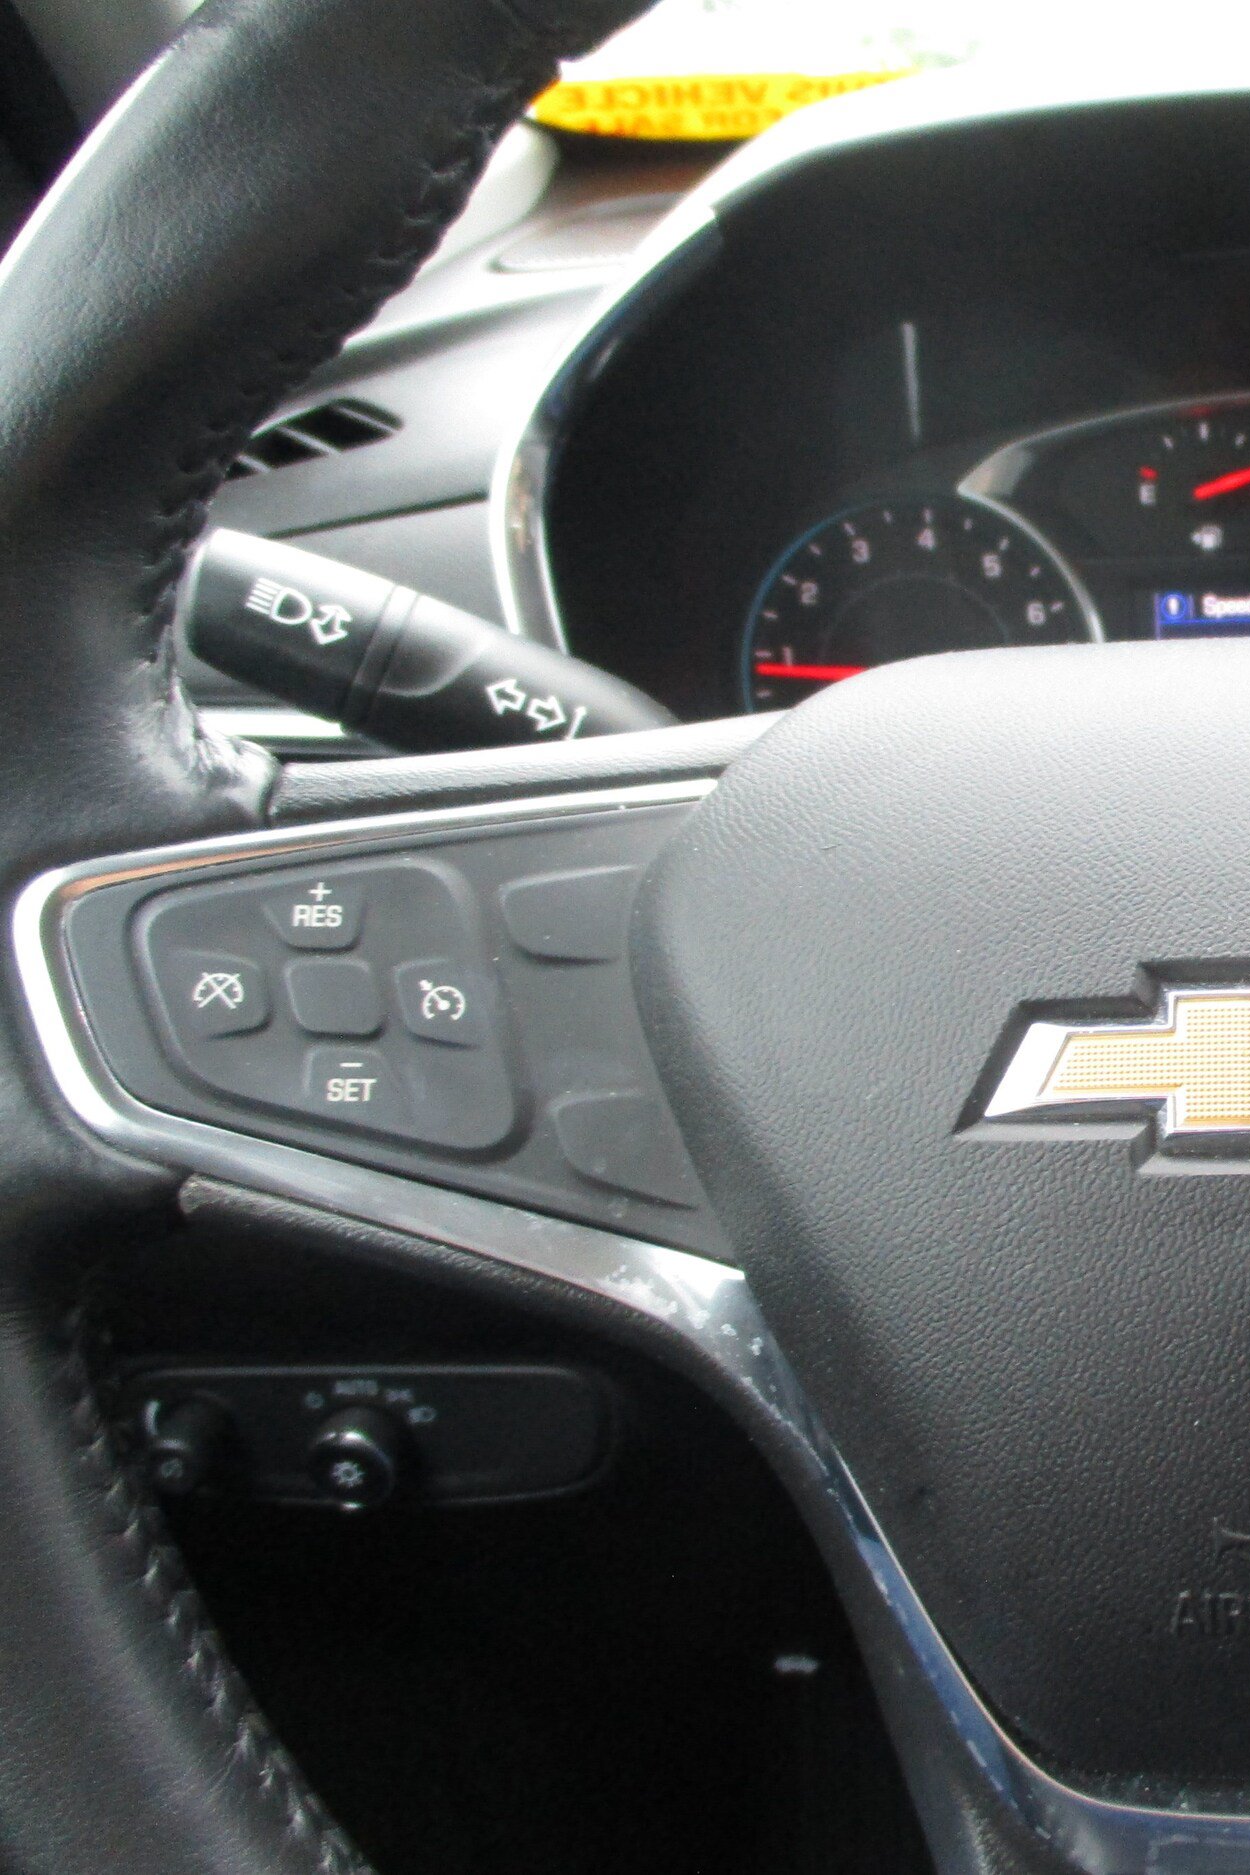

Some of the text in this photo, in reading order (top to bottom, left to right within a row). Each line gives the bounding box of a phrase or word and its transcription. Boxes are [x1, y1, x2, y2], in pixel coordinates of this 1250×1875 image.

[852, 538, 870, 564] 3
[917, 527, 936, 551] 4
[981, 553, 1001, 578] 5
[799, 581, 819, 605] 2
[1026, 601, 1046, 626] 6
[291, 904, 343, 929] RES
[326, 1078, 378, 1103] SET
